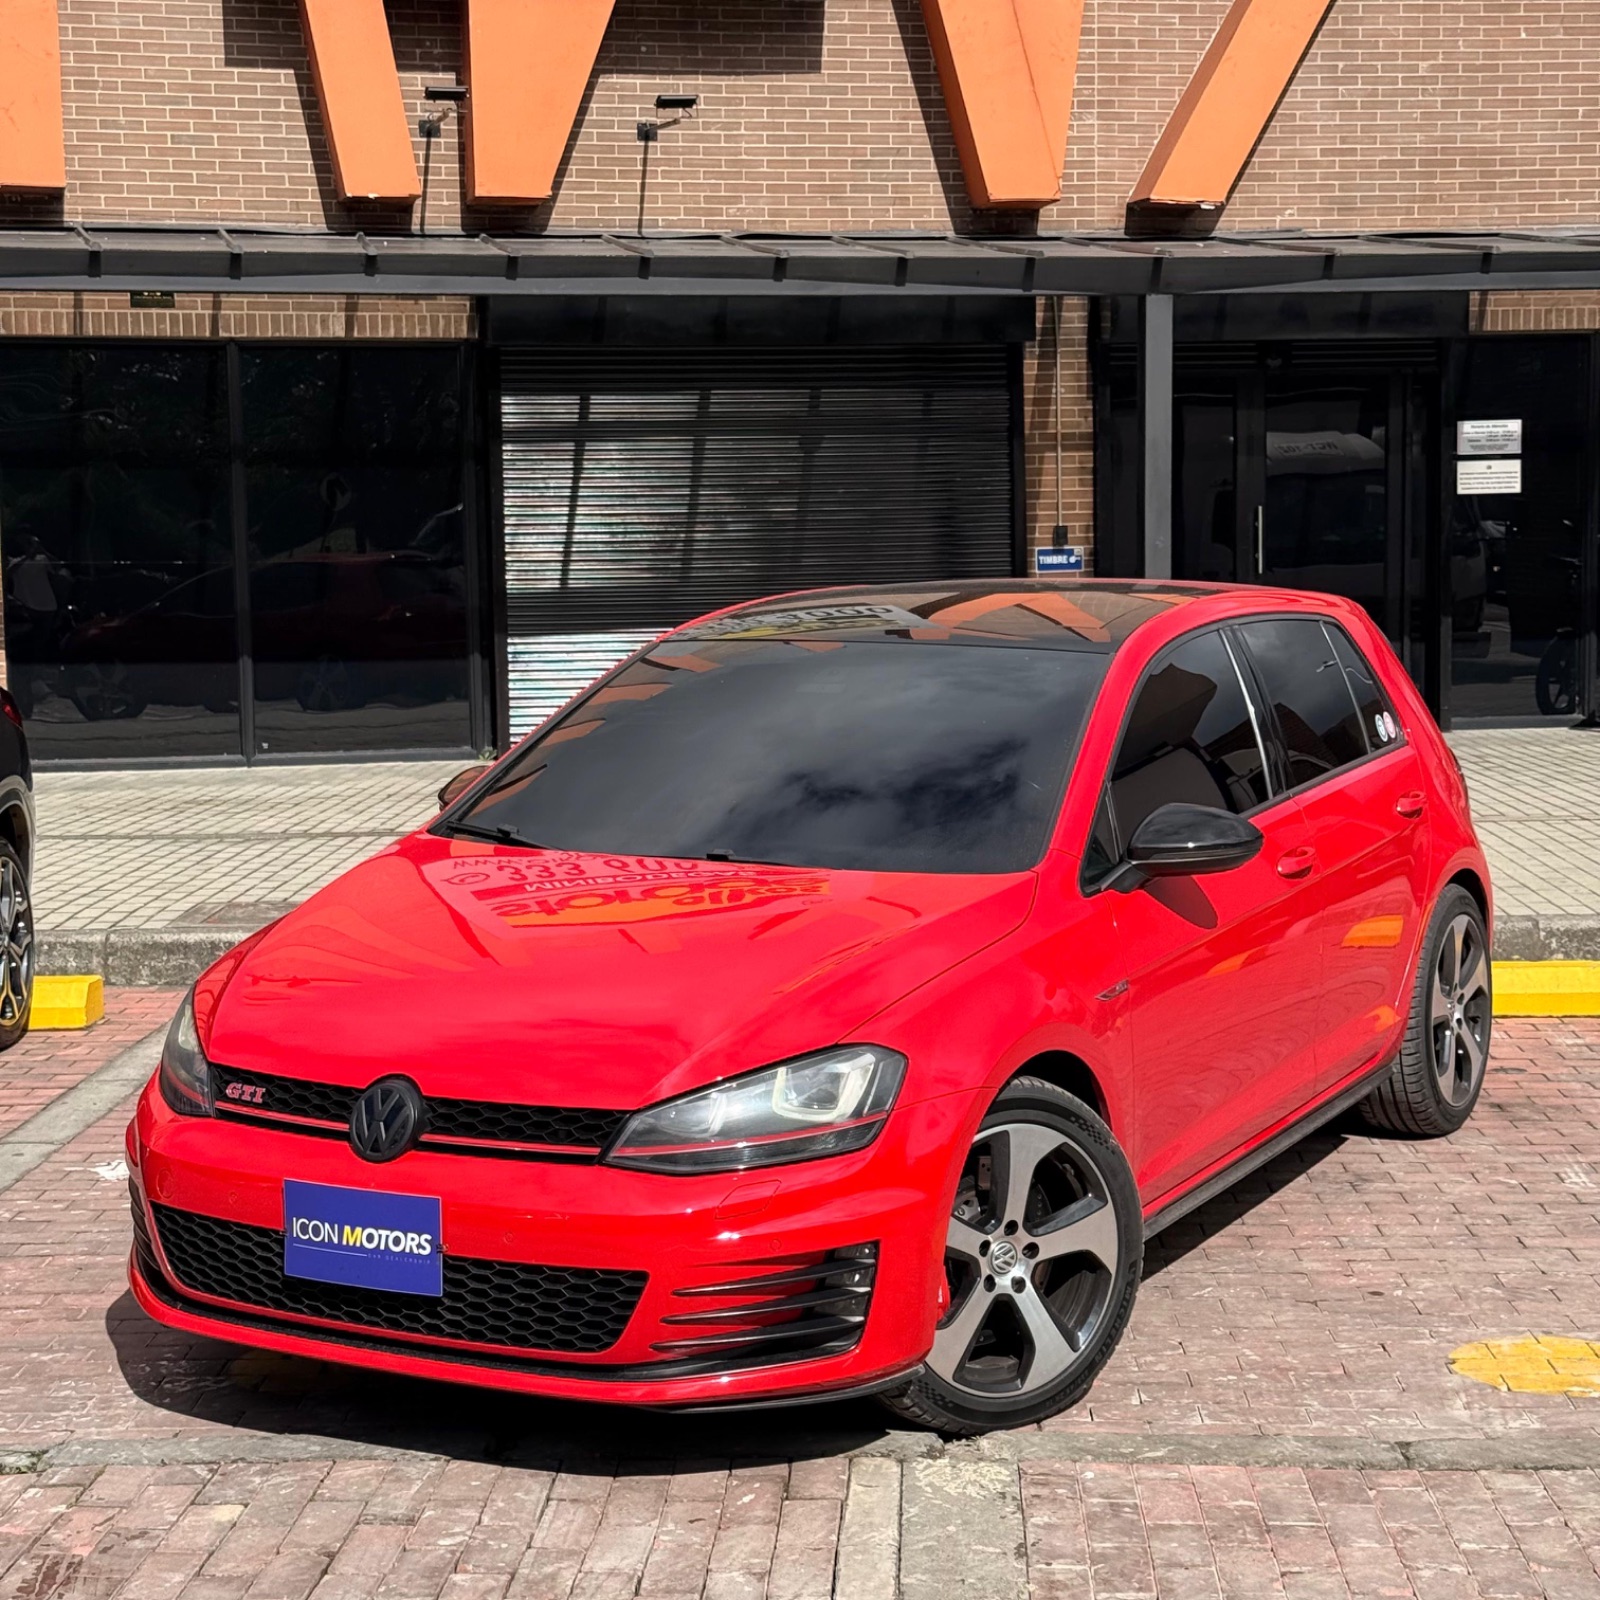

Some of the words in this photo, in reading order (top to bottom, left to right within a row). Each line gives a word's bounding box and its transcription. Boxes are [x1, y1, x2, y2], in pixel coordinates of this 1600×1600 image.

[1038, 555, 1069, 565] TIMBRE
[225, 1082, 266, 1104] GTI
[292, 1217, 339, 1244] ICON
[342, 1225, 433, 1256] MOTORS
